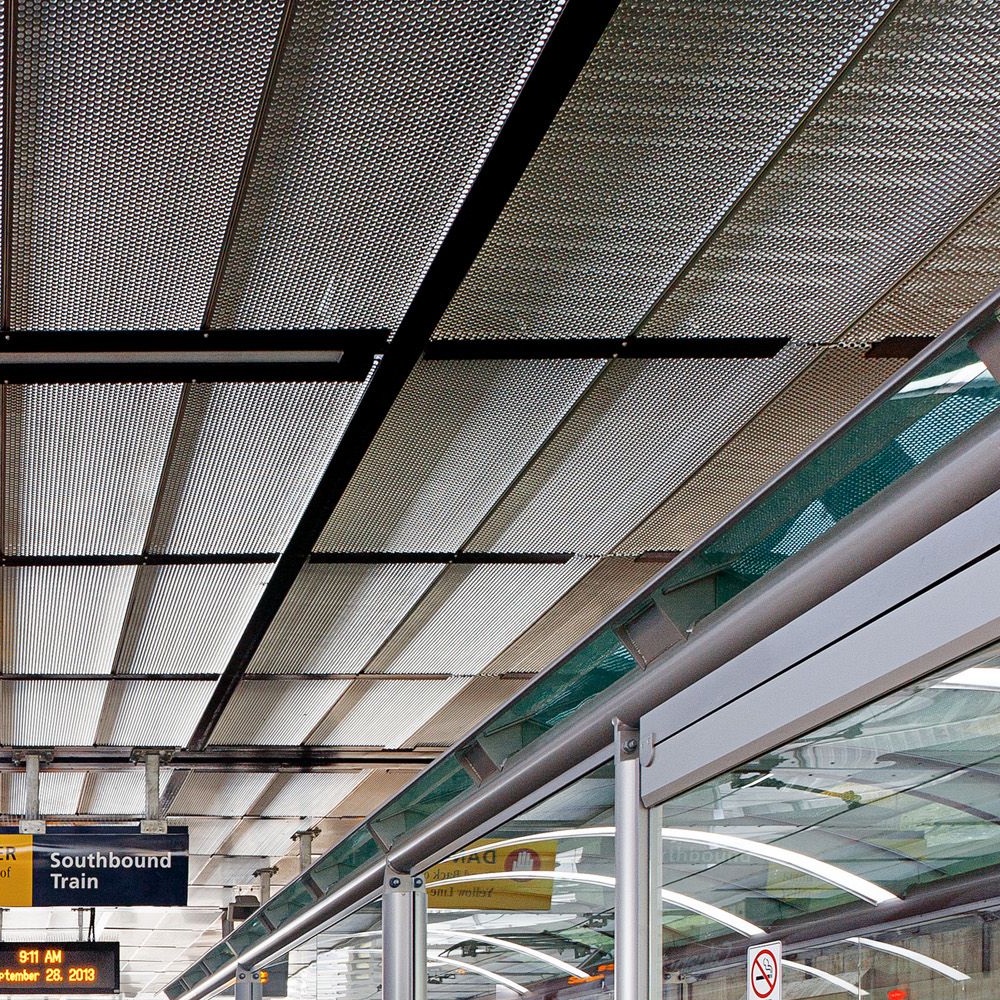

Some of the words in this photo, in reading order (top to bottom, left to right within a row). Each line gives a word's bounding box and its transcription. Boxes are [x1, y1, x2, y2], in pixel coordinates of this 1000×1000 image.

[50, 851, 172, 869] Southbound
[0, 867, 11, 879] of
[50, 873, 99, 889] Train
[18, 949, 39, 964] 9:11
[43, 949, 62, 963] AM
[68, 967, 96, 982] 2013
